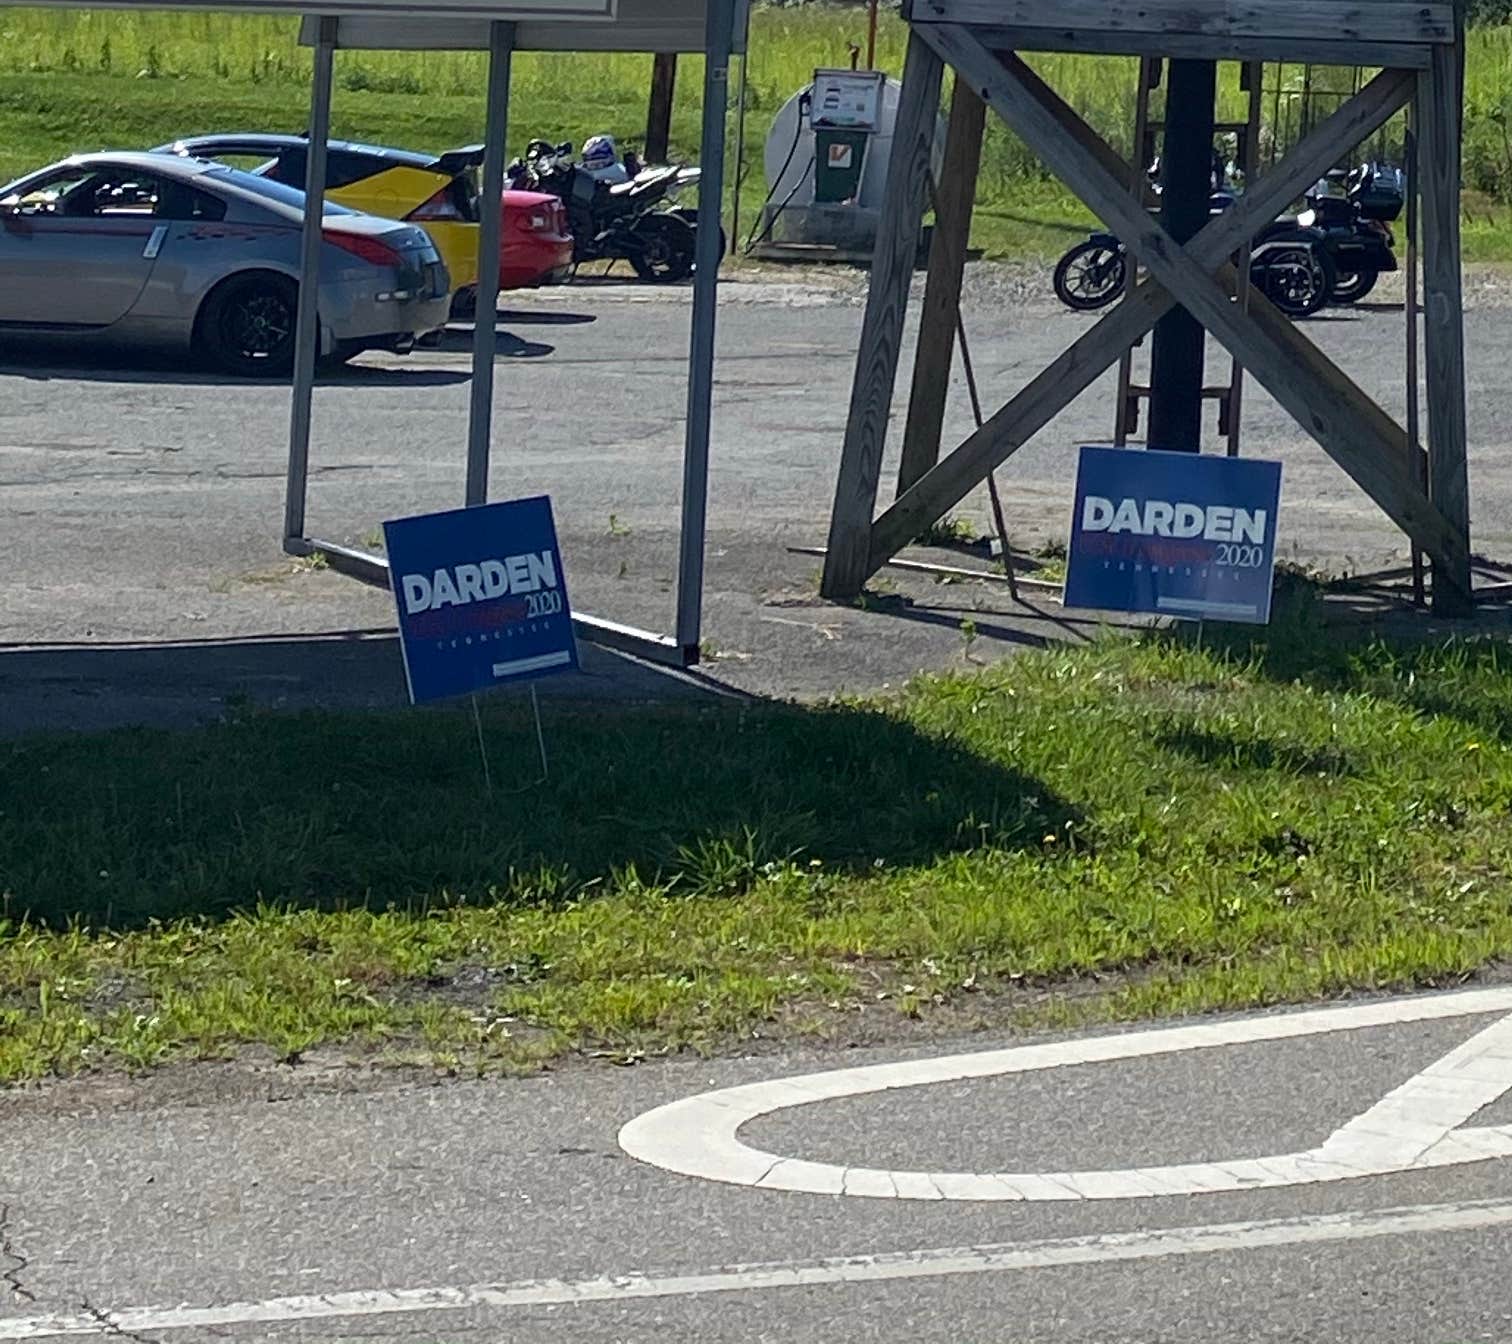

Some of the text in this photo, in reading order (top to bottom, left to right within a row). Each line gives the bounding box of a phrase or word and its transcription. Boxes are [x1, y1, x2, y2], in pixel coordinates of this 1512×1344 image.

[1081, 495, 1267, 544] DARDEN
[1215, 544, 1263, 568] 2020
[402, 550, 558, 615] DARDEN
[524, 591, 562, 618] 2020
